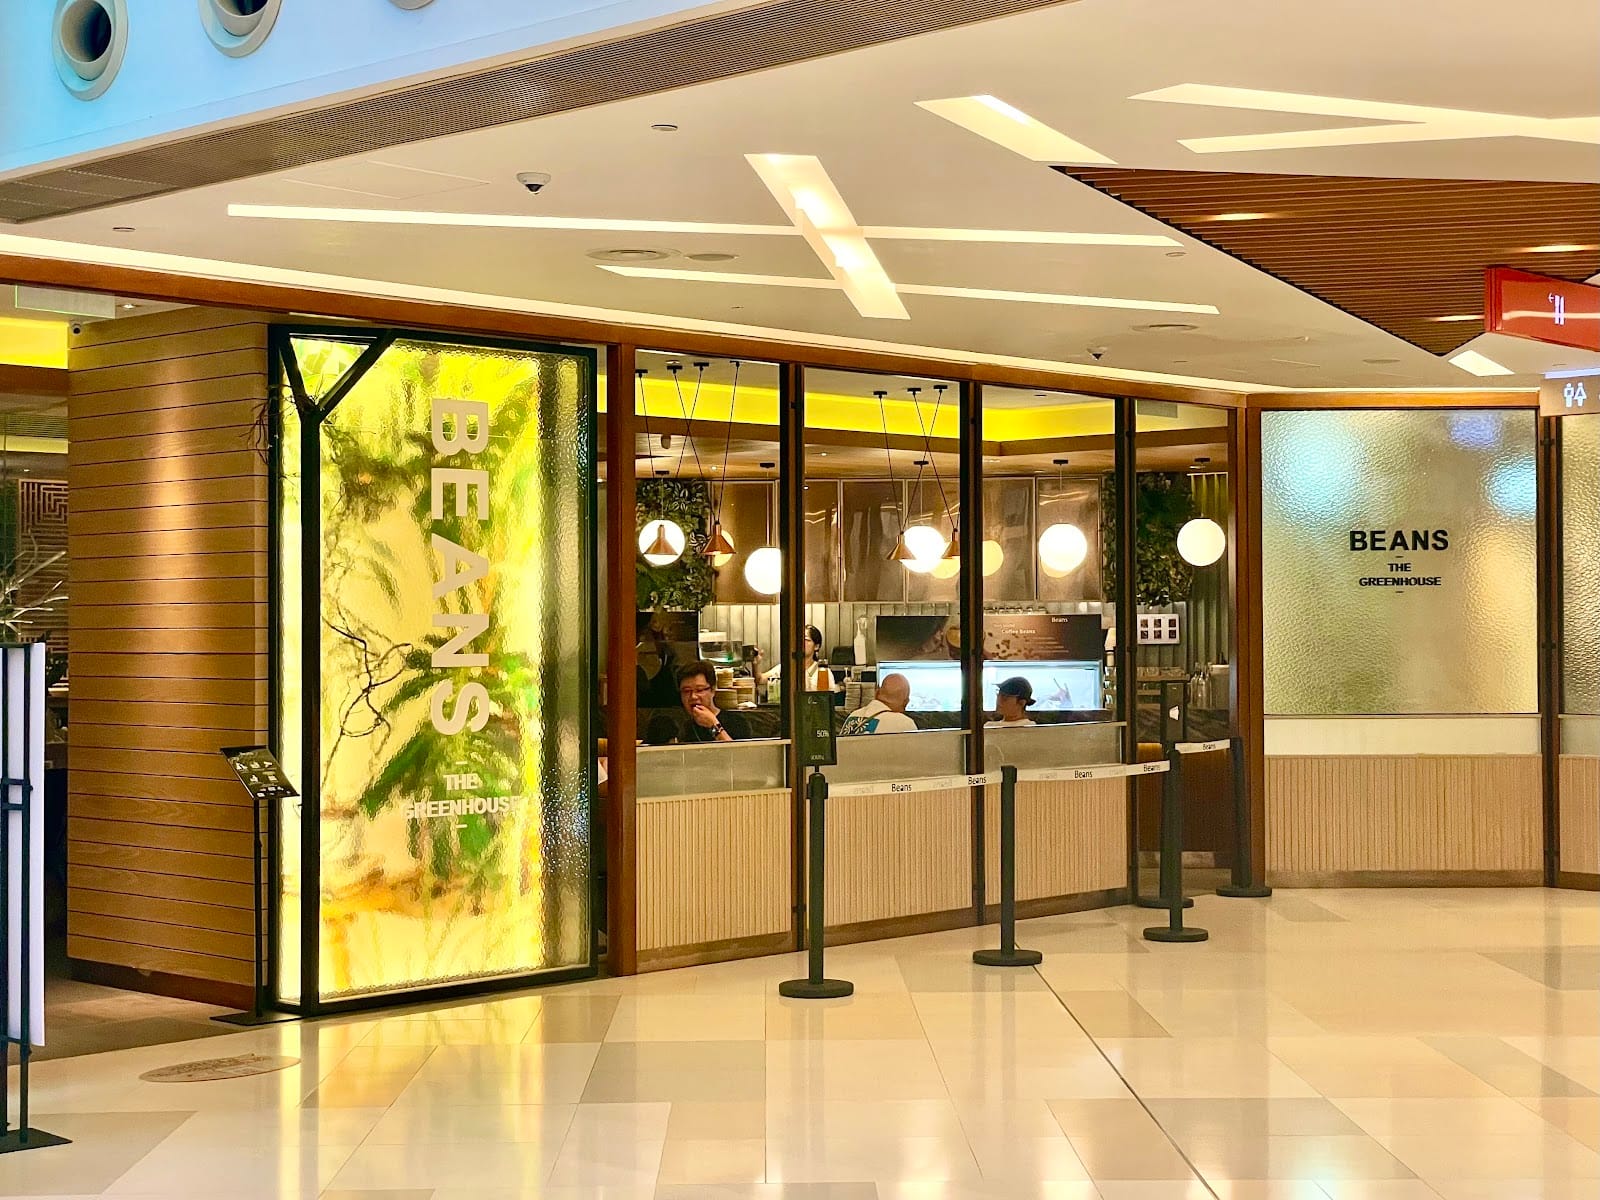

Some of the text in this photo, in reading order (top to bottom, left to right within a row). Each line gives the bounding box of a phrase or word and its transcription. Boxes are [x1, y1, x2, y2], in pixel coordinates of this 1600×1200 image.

[1349, 529, 1449, 551] BEANS
[431, 398, 490, 736] BEANS
[1387, 562, 1412, 572] THE
[1358, 576, 1442, 587] GREENHOUSE
[1202, 743, 1217, 751] Beans
[1143, 763, 1161, 772] Beans
[1074, 770, 1093, 779] Beans
[443, 773, 482, 791] THE
[968, 777, 987, 786] Beans
[891, 783, 912, 793] Beans
